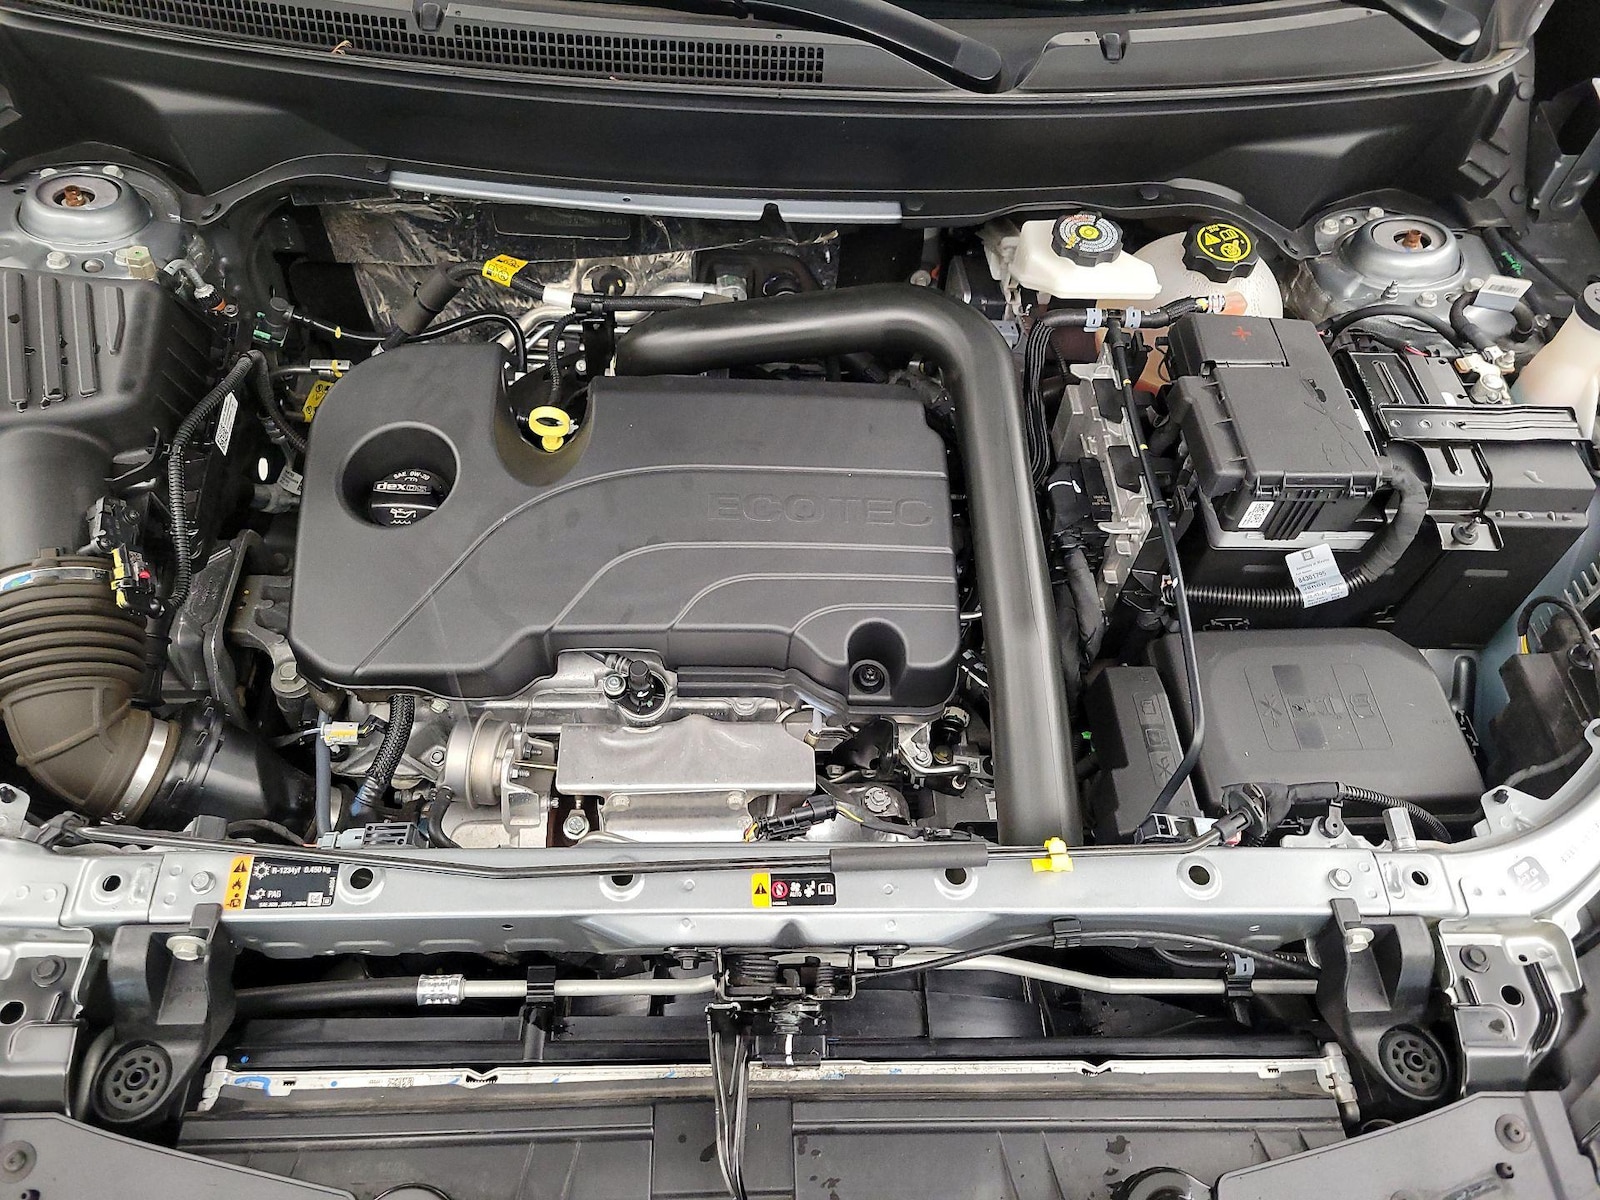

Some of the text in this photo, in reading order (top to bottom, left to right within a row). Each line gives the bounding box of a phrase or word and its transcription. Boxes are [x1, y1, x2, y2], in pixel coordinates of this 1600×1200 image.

[393, 471, 431, 481] SAE 0W-20
[376, 482, 428, 492] dexos
[706, 493, 934, 527] ECOTEC
[271, 866, 331, 875] R-1234yf 0.450 kg
[267, 890, 282, 899] PAG
